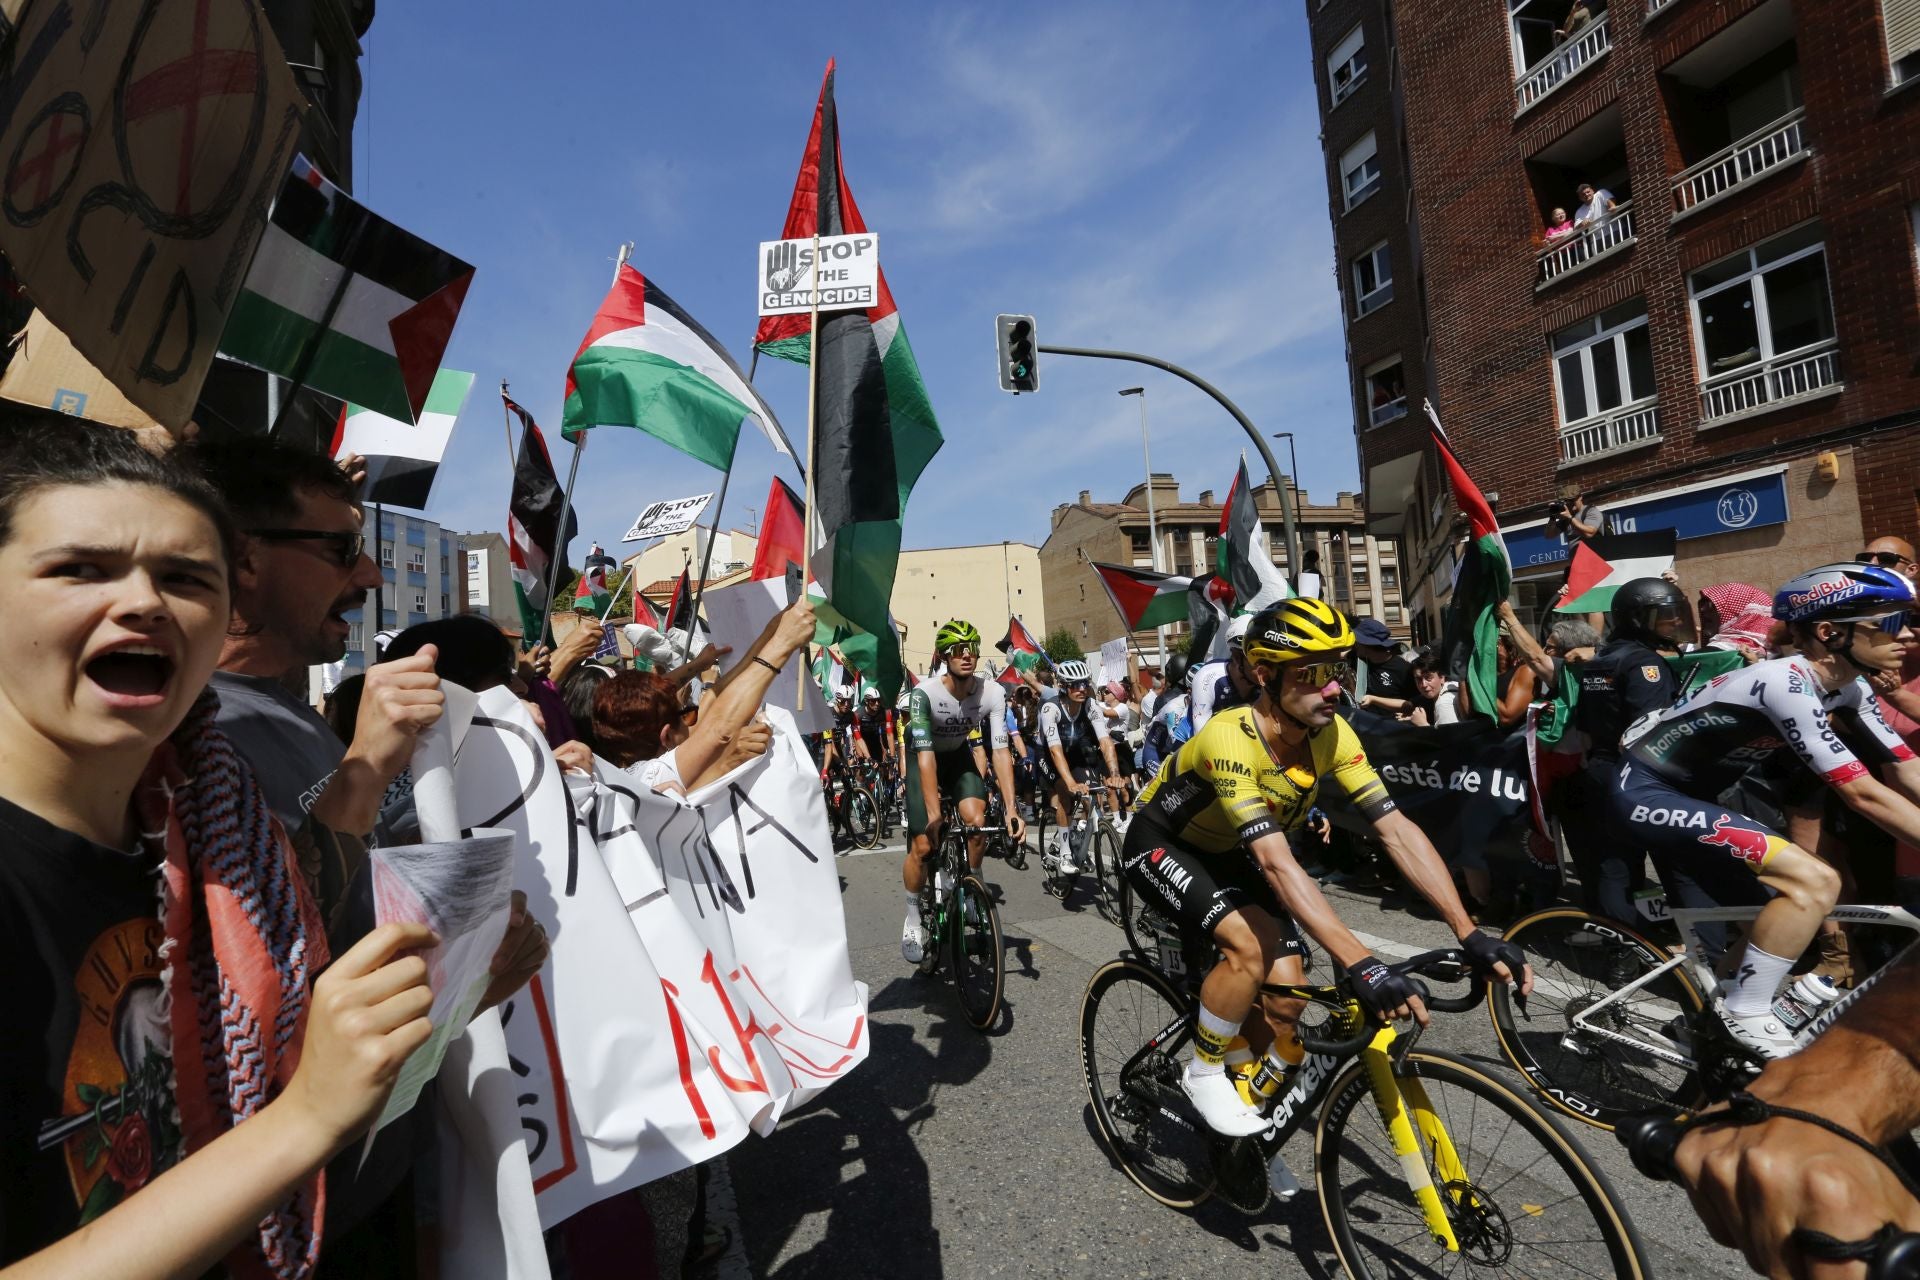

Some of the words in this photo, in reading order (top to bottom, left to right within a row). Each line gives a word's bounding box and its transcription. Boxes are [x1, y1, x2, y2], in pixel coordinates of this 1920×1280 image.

[798, 238, 872, 266] STOP
[817, 268, 849, 283] THE
[764, 287, 871, 308] GENOCIDE
[663, 496, 708, 515] STOP
[665, 512, 686, 521] THE
[630, 521, 690, 536] GENOCIDE
[1529, 550, 1568, 564] CENTR
[1788, 584, 1865, 620] SPECIALIZED
[1789, 584, 1821, 608] Red
[1819, 575, 1857, 597] Bull
[1264, 630, 1301, 648] GIRO
[1644, 711, 1738, 758] hansgrohe
[1781, 717, 1814, 764] BORA
[1812, 708, 1847, 755] BOSS
[1213, 758, 1252, 777] VISMA
[1382, 760, 1444, 790] está
[1449, 765, 1481, 793] de
[1215, 778, 1237, 787] ease
[1630, 804, 1707, 829] BORA
[1241, 821, 1271, 838] RAM
[1158, 856, 1194, 894] VISMA
[1201, 900, 1227, 929] nimbl
[1832, 909, 1890, 920] ECIALIZED
[1778, 1001, 1799, 1021] BORA
[1327, 1080, 1363, 1132] RESERVE
